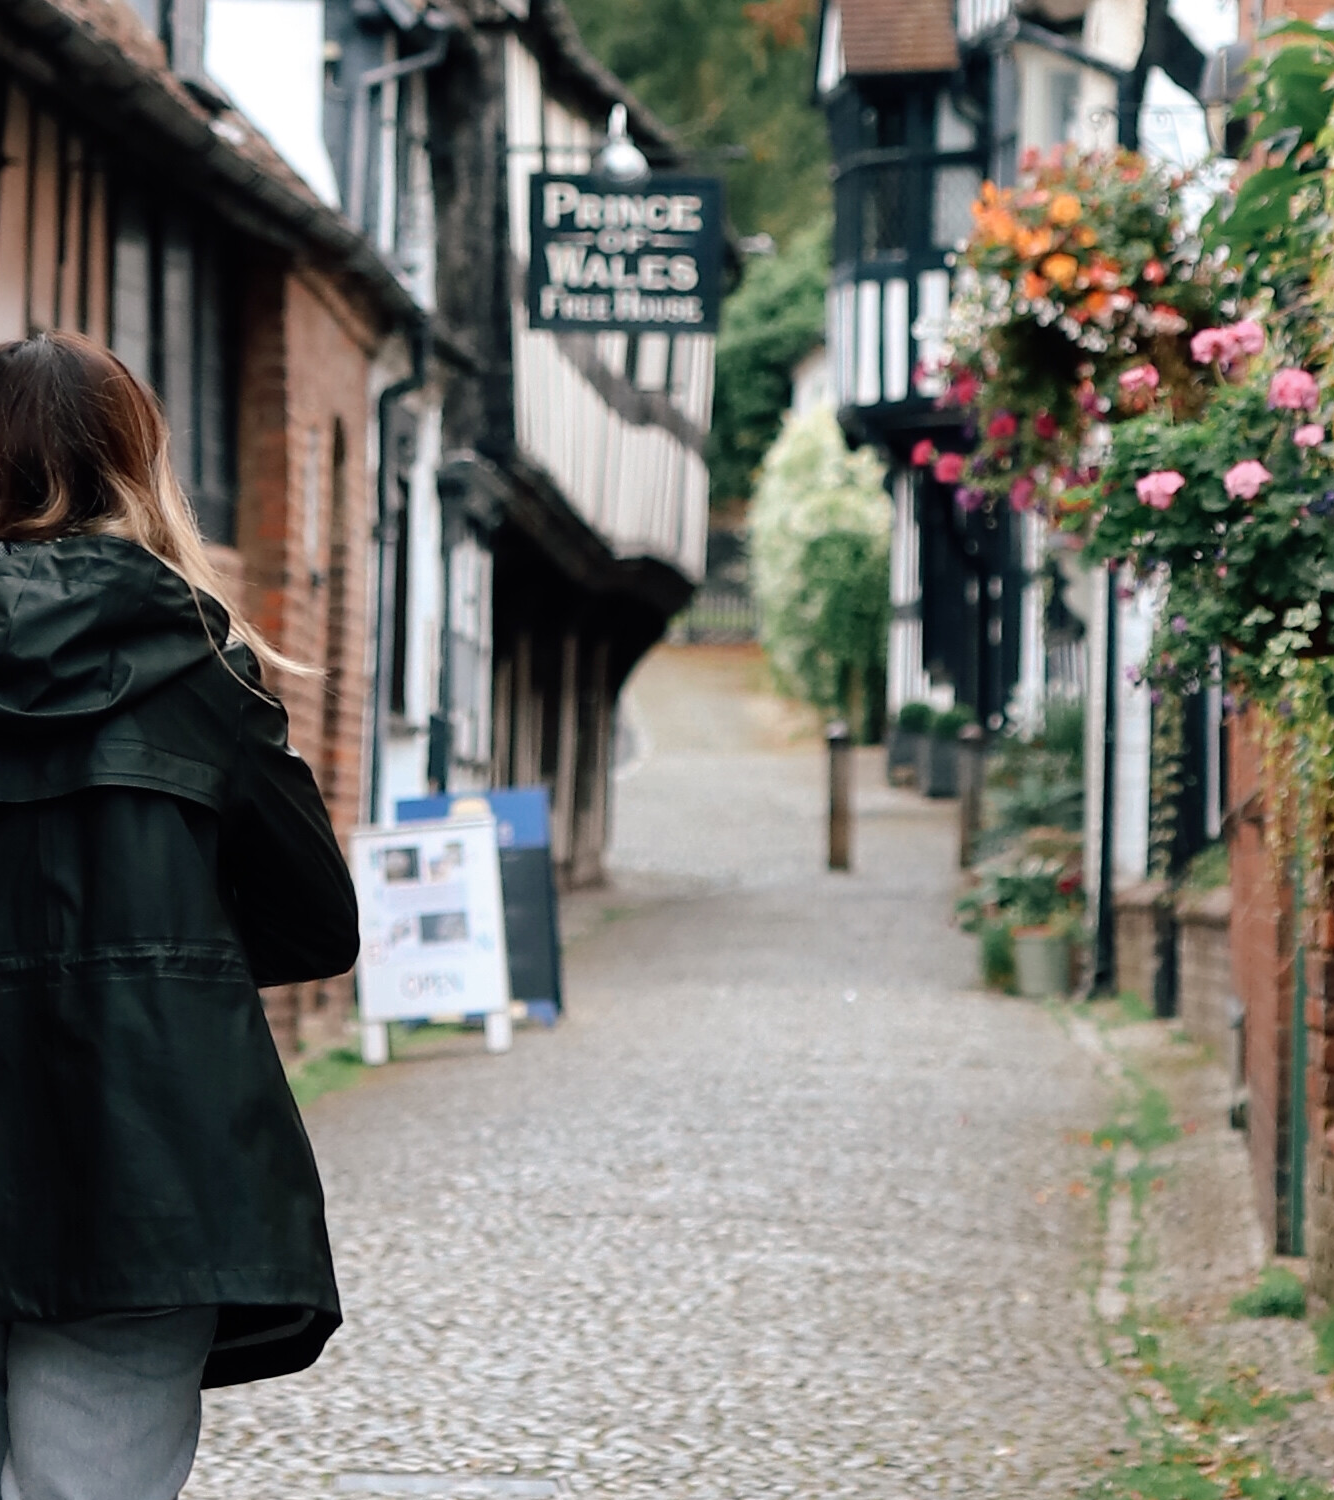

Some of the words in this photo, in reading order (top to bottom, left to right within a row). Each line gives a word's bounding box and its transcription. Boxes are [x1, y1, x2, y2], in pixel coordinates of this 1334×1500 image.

[543, 182, 704, 232] PRINCE
[596, 227, 652, 255] OF
[544, 241, 699, 292] WALES
[540, 284, 612, 322] FREE
[614, 288, 704, 324] HOUSE
